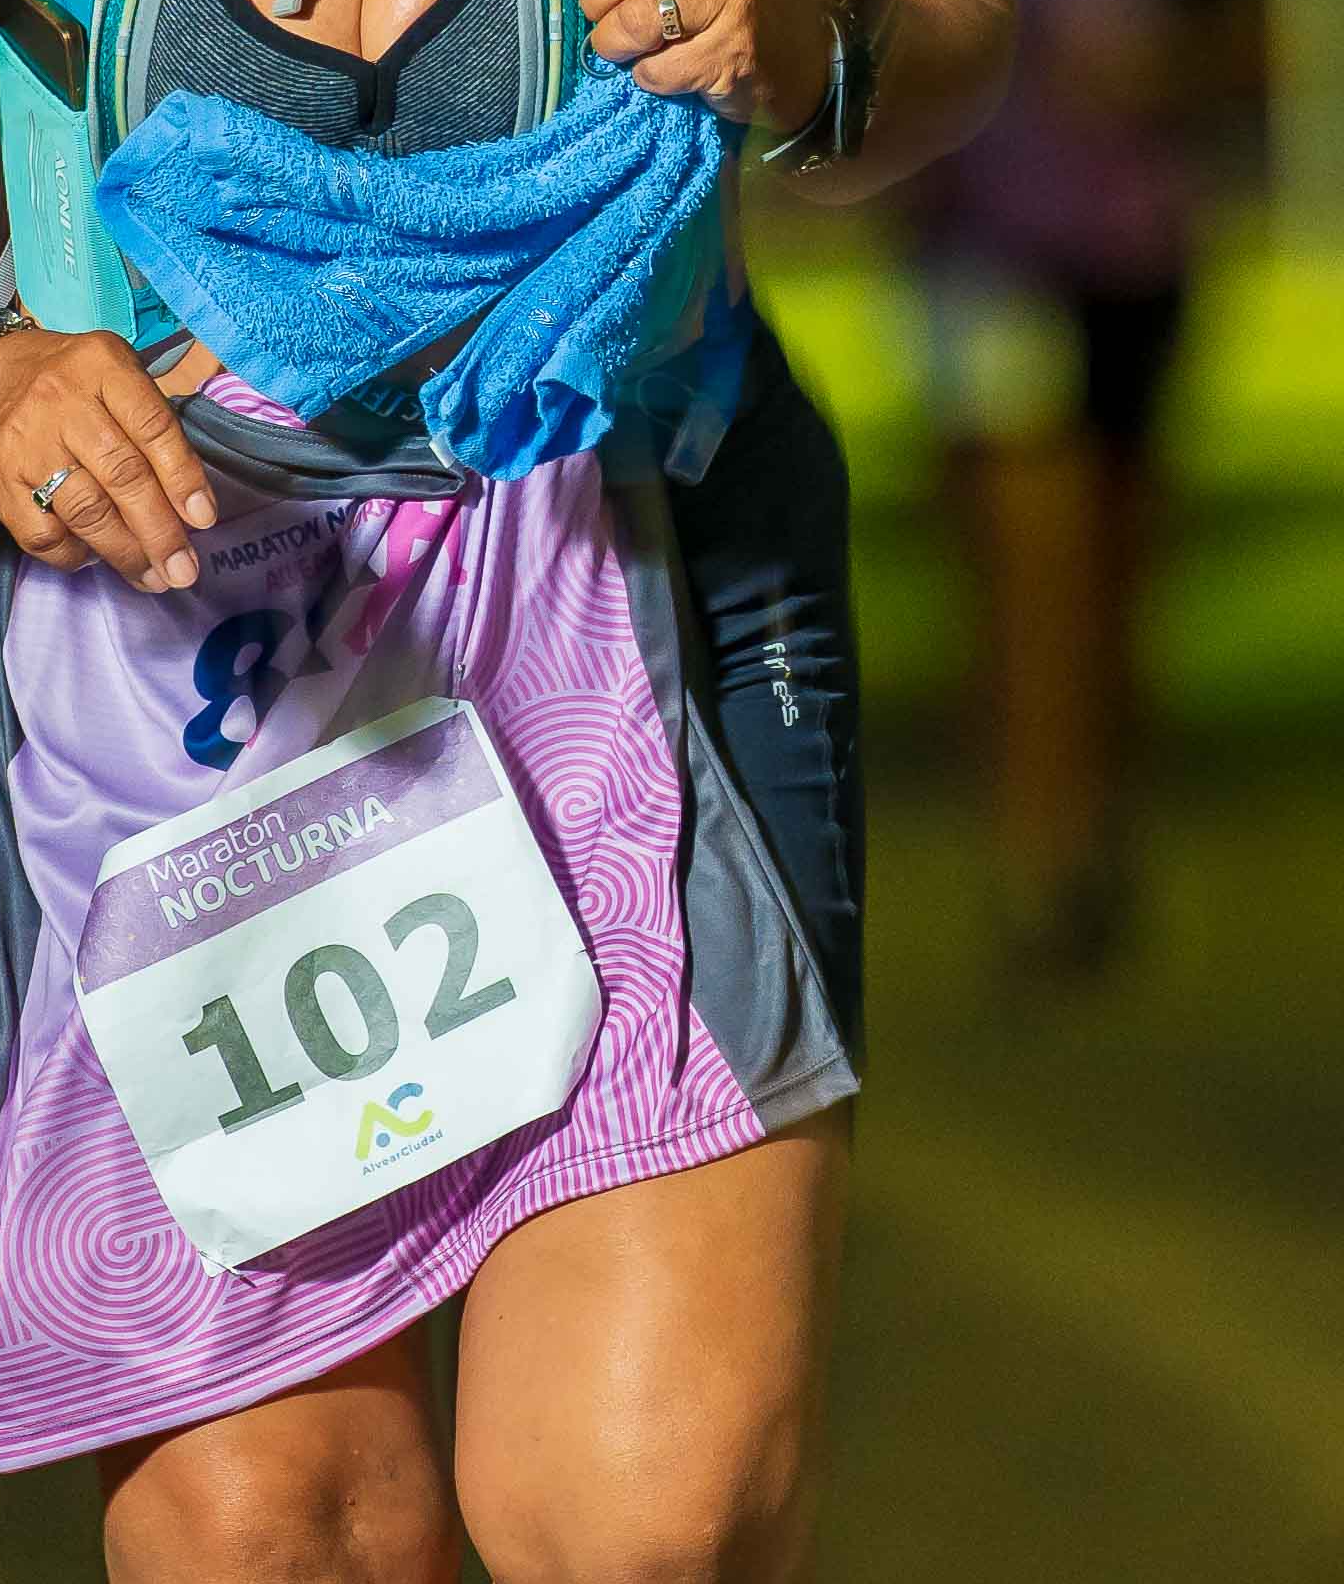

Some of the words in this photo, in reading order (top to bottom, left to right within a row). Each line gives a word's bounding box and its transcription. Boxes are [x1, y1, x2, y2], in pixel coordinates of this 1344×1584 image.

[145, 810, 286, 893] Maratón
[159, 795, 395, 930] NOCTURNA
[181, 892, 518, 1136] 102
[361, 1128, 445, 1176] AlvearCiudad
